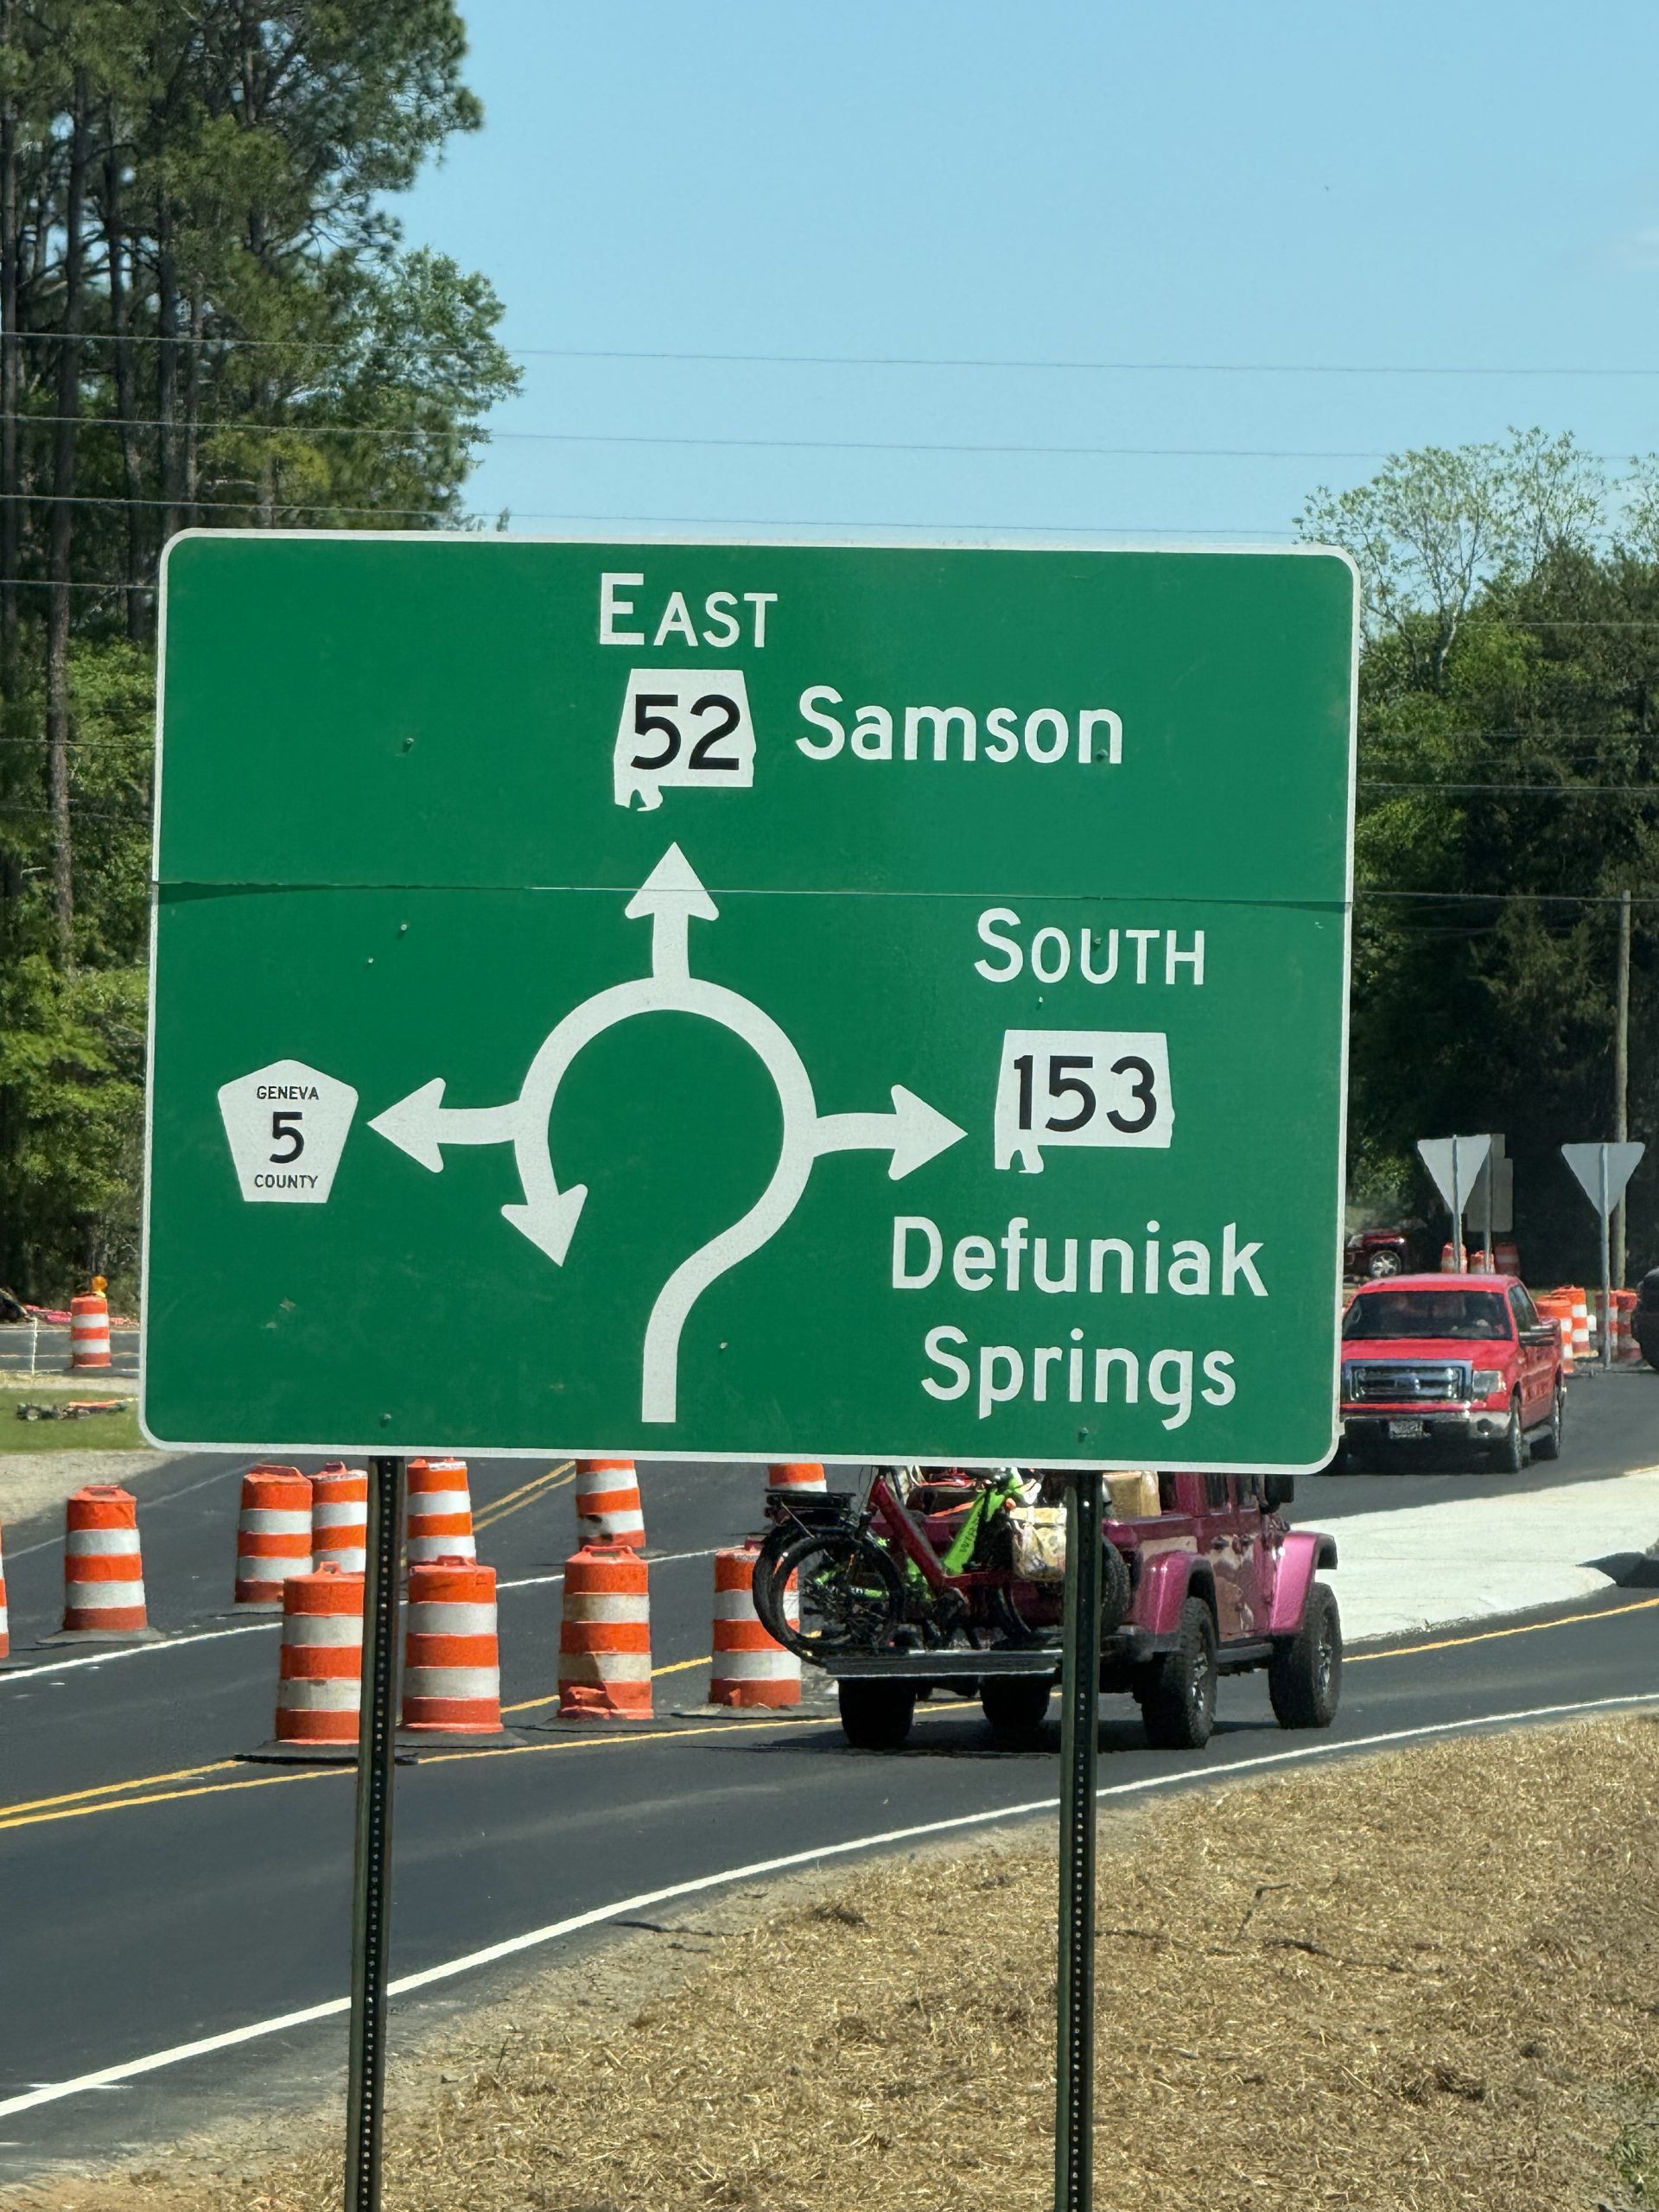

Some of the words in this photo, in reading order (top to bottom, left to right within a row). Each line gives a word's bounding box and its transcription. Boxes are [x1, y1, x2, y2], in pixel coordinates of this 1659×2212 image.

[599, 572, 779, 647] EAST
[630, 694, 741, 771] 52
[795, 685, 1124, 764] Samson
[974, 907, 1205, 985] SOUTH
[257, 1085, 320, 1100] GENEVA
[1014, 1054, 1158, 1134] 153
[269, 1111, 305, 1164] 5
[254, 1173, 319, 1189] COUNTY
[892, 1216, 1269, 1297] Defuniak
[921, 1325, 1237, 1431] Springs
